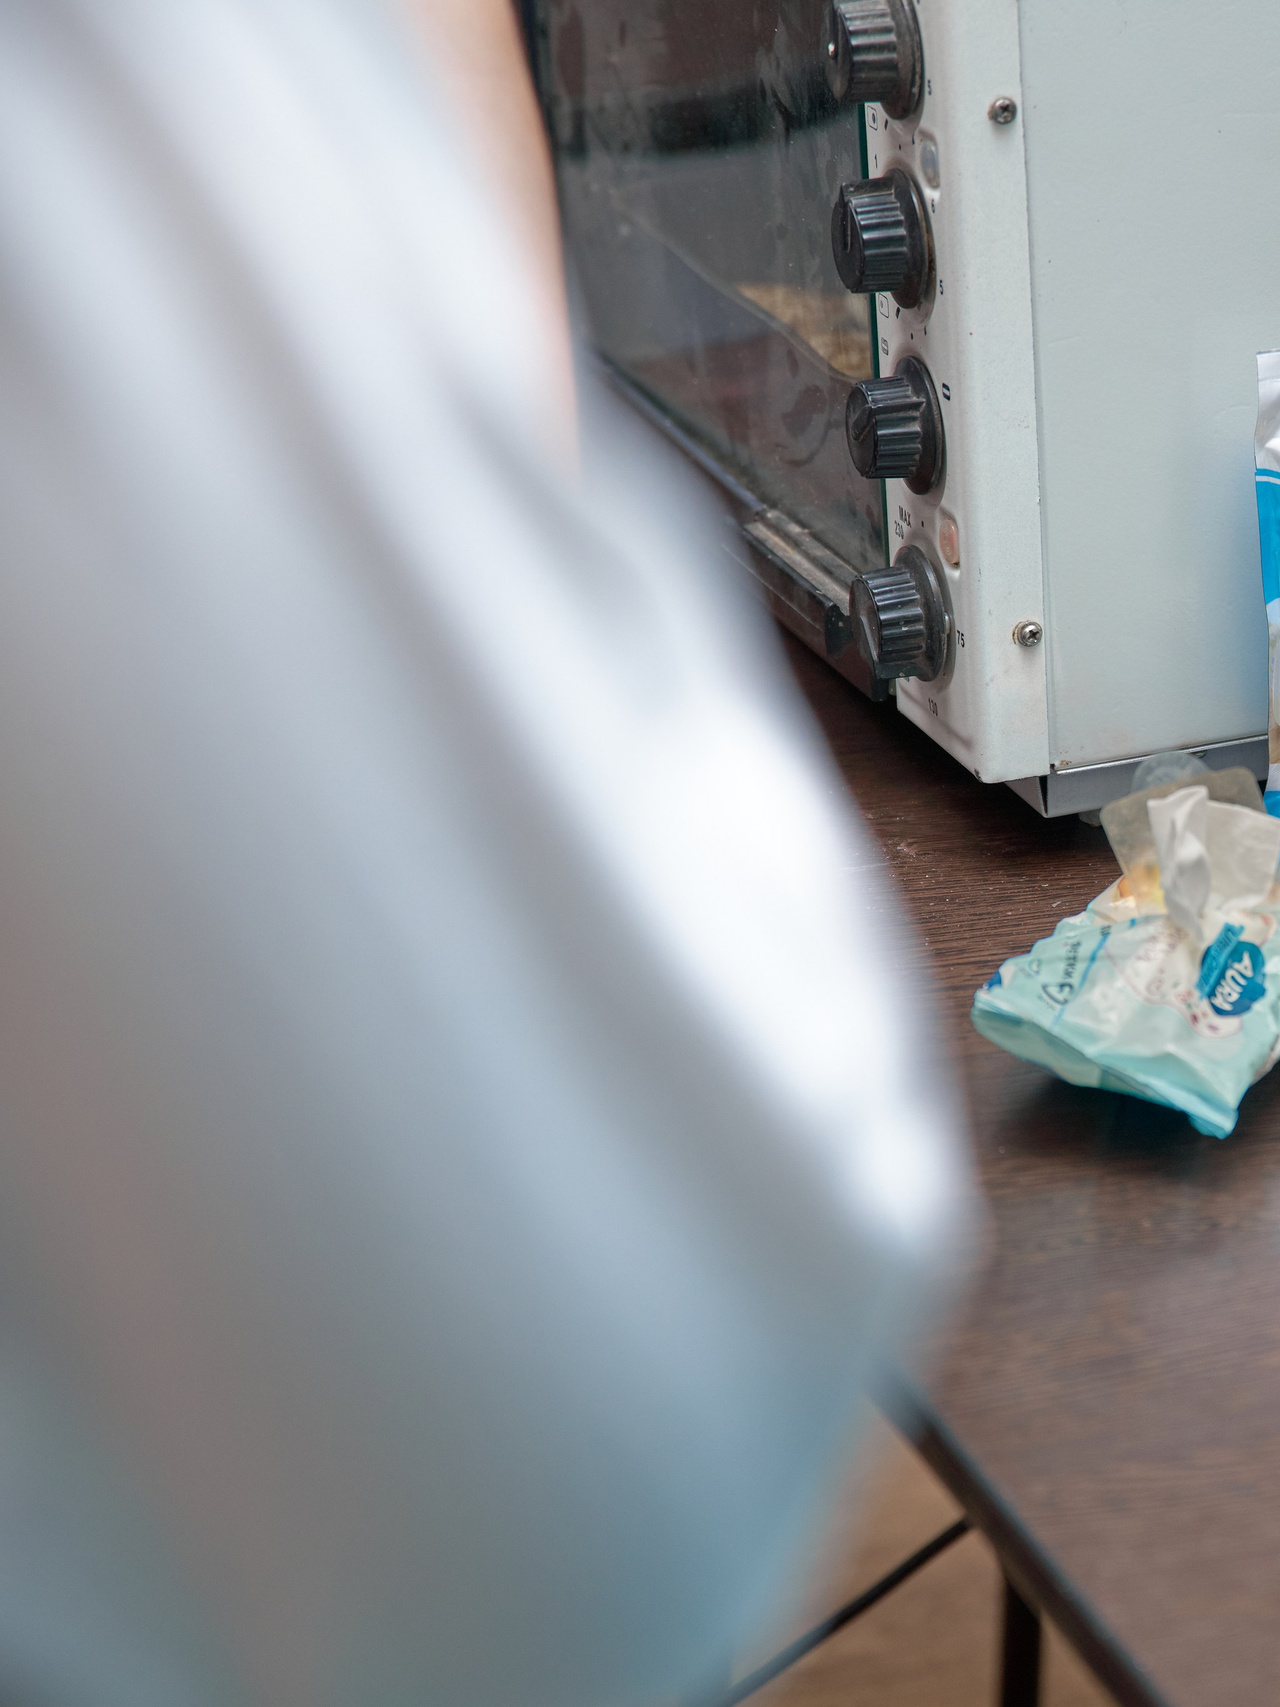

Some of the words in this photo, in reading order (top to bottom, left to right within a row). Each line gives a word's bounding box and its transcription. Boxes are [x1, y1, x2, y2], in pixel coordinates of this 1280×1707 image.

[898, 505, 912, 528] MAX
[956, 629, 966, 648] 75
[928, 697, 939, 717] 130
[1209, 950, 1255, 1012] AURA
